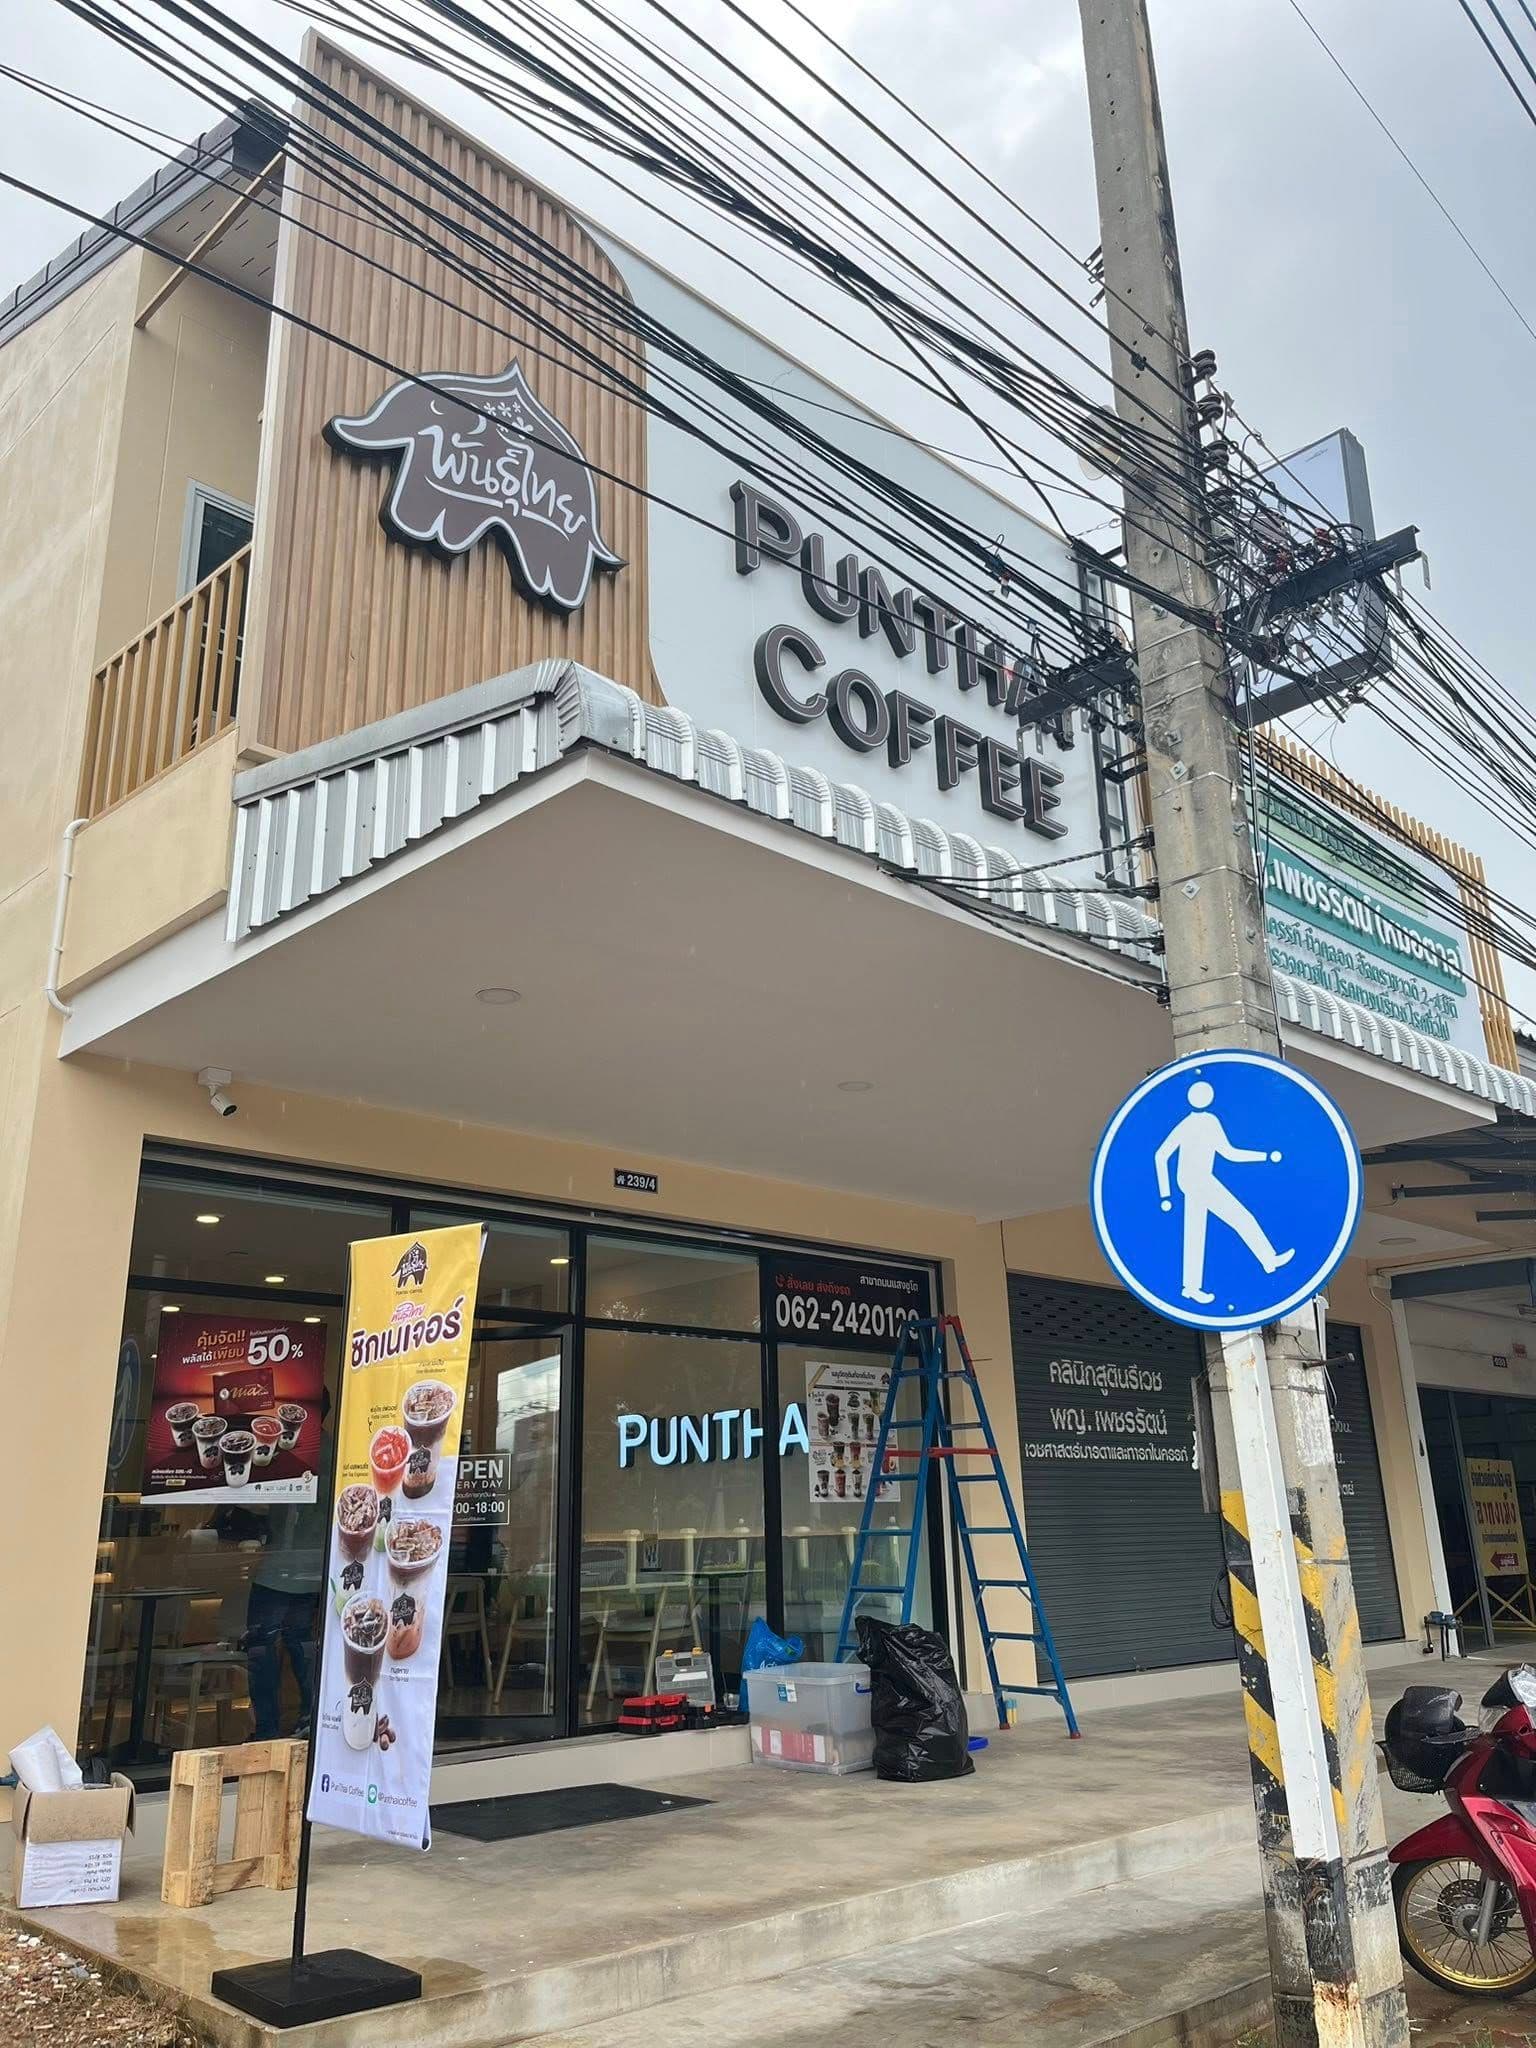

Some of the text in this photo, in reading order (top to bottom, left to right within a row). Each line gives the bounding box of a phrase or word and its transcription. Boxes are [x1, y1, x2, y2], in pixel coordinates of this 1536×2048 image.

[418, 424, 587, 534] พันธุ์ไทย
[728, 479, 1068, 750] PUNTHA
[754, 624, 1069, 840] COFFEE
[627, 1174, 656, 1191] 239/4
[197, 1330, 246, 1352] คุ้มจัด!!
[351, 1297, 464, 1368] ซิกเนเจอร์
[247, 1333, 304, 1367] 50%
[1049, 1359, 1163, 1397] คลินิกสูตินรีเวช
[457, 1479, 504, 1489] ERY DAY
[458, 1459, 504, 1480] PEN
[348, 1785, 365, 1798] Coffee
